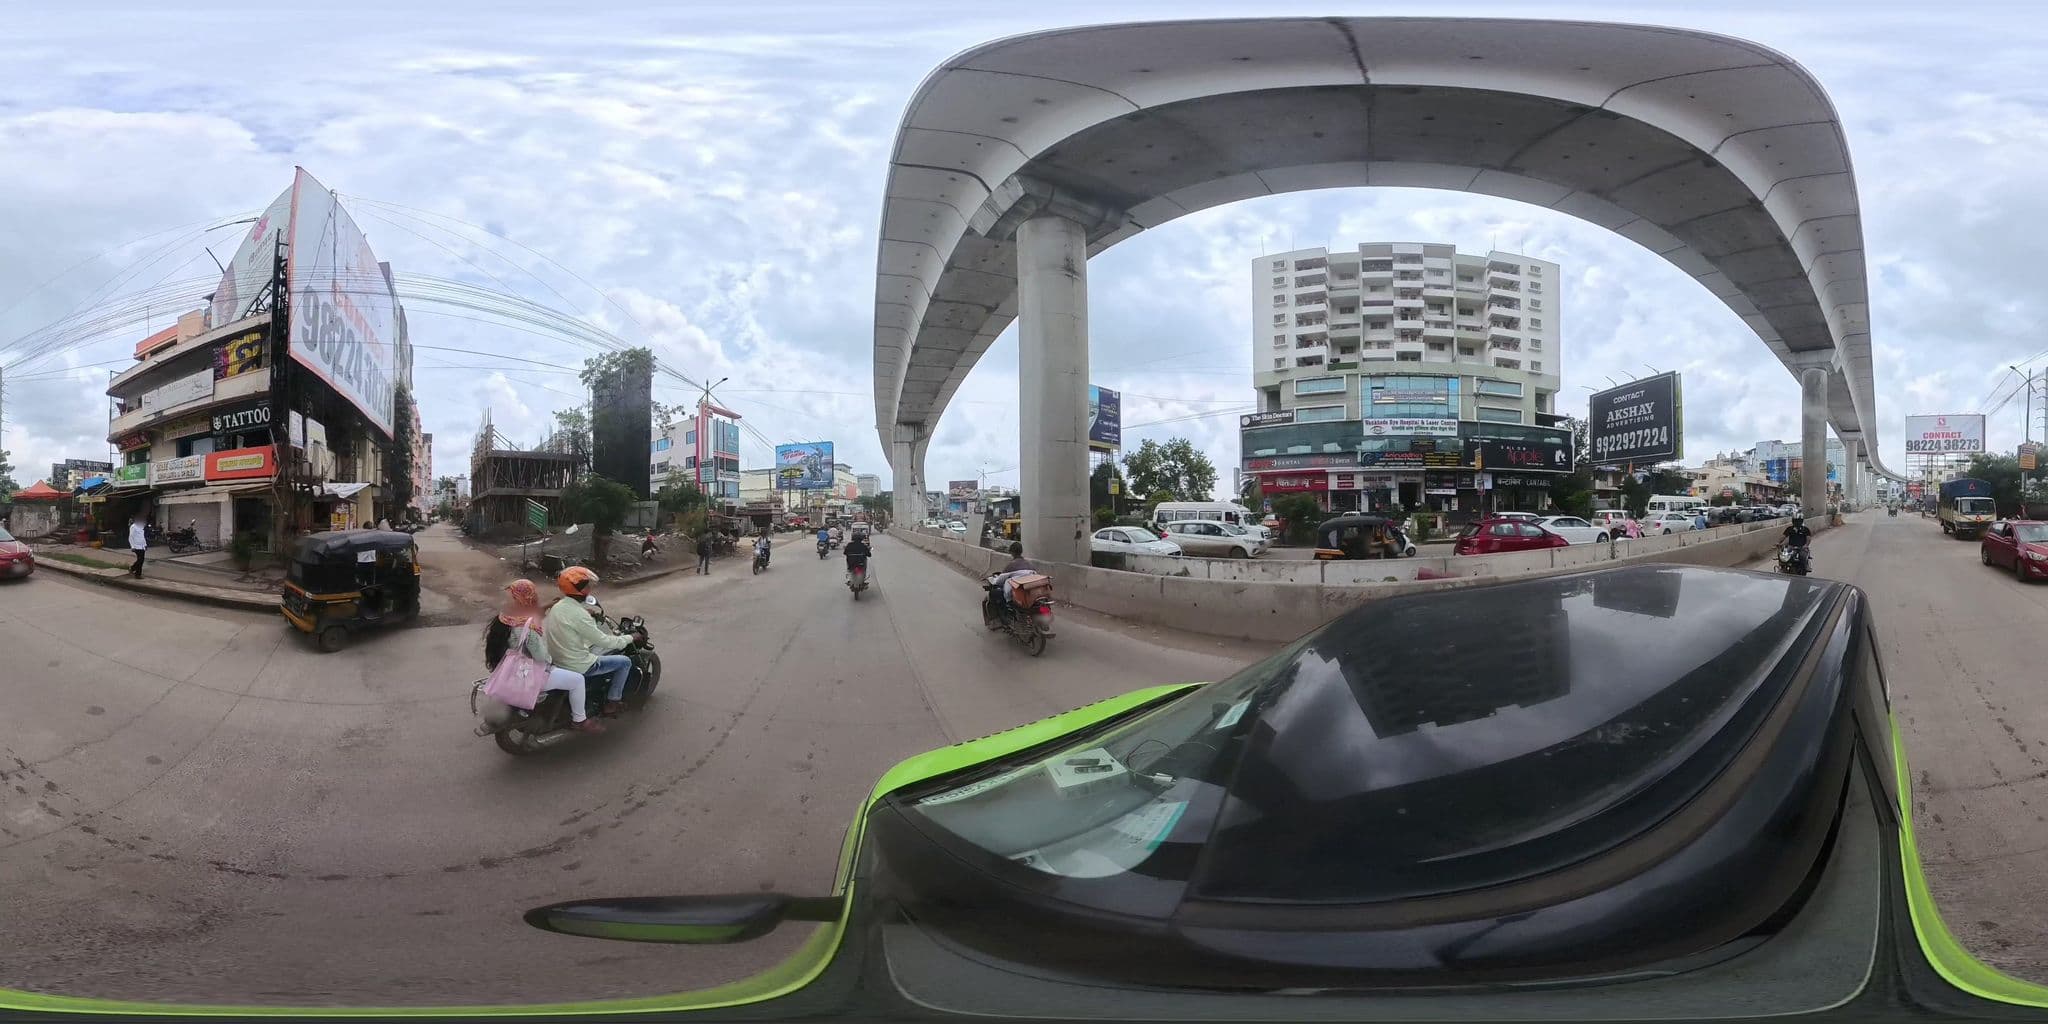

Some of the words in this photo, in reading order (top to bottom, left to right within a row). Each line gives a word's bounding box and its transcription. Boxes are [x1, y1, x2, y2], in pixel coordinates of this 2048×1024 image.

[302, 285, 362, 394] 98224
[1613, 390, 1645, 404] CONTACT
[223, 407, 270, 428] TATTOO
[1606, 402, 1655, 422] AKSHAY
[1606, 414, 1654, 429] ADVERTISING
[1596, 426, 1668, 453] 9922927224
[1906, 440, 1941, 451] 98224
[1944, 439, 1980, 451] 38273
